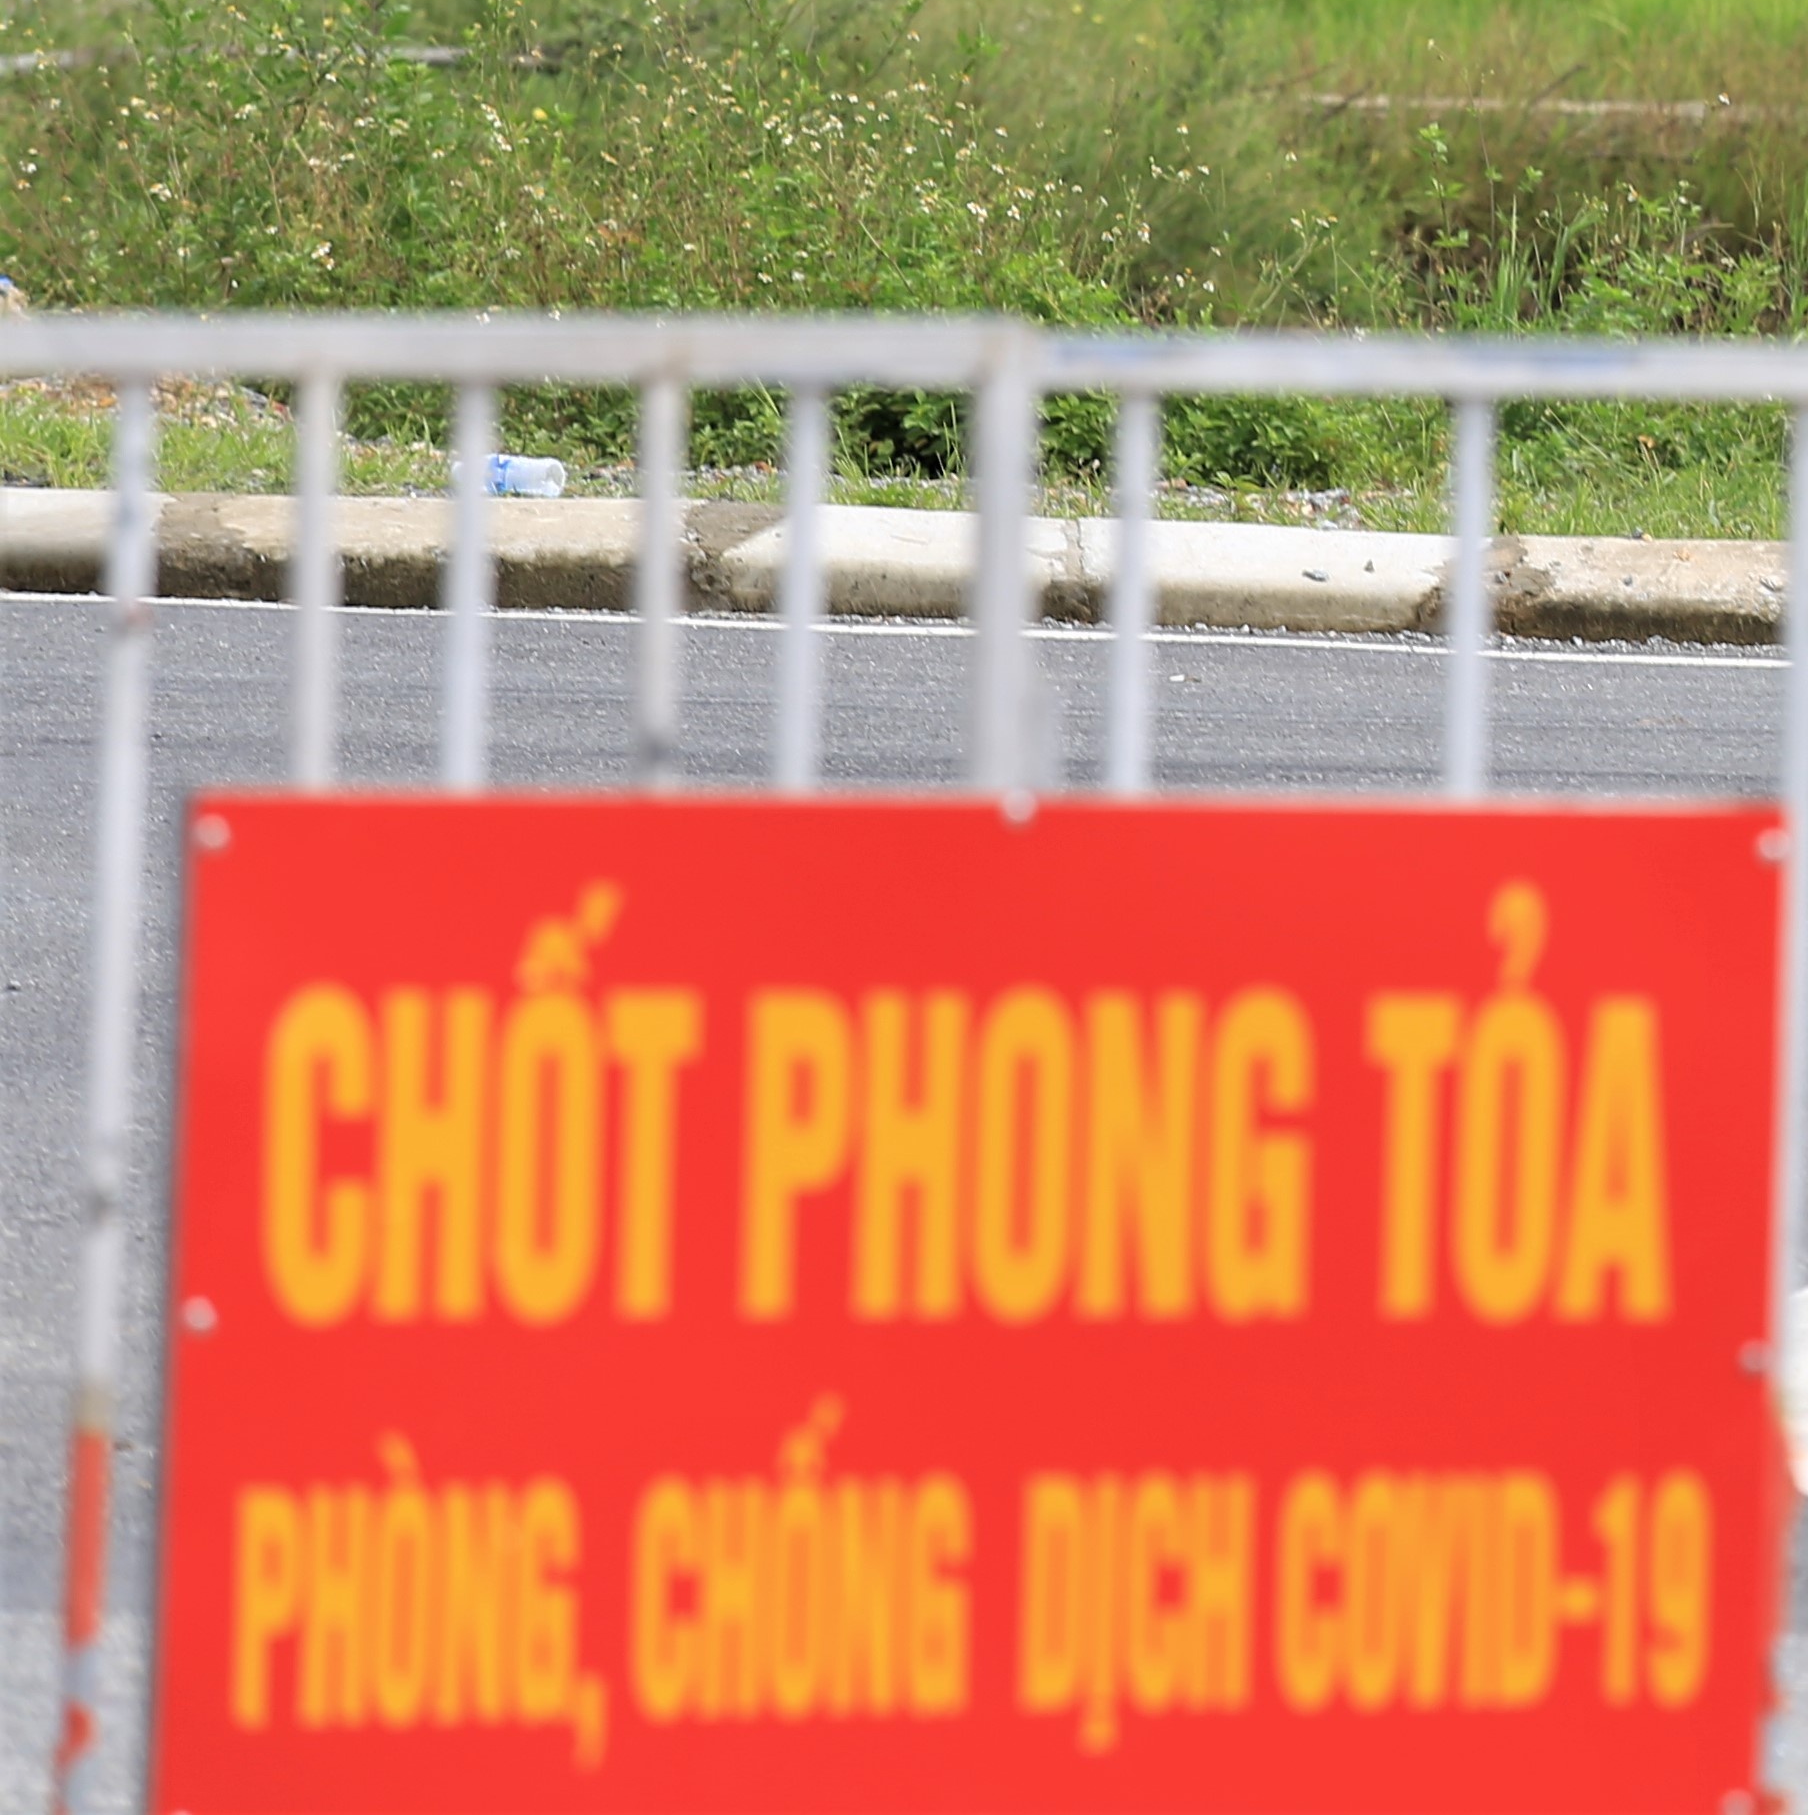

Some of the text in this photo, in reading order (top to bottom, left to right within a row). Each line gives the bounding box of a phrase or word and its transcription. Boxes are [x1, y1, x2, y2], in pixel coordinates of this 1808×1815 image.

[262, 882, 1669, 1326] CHỐT PHONG TỎA
[232, 1399, 1709, 1762] PHÒNG, CHỐNG DỊCH COVID-19
